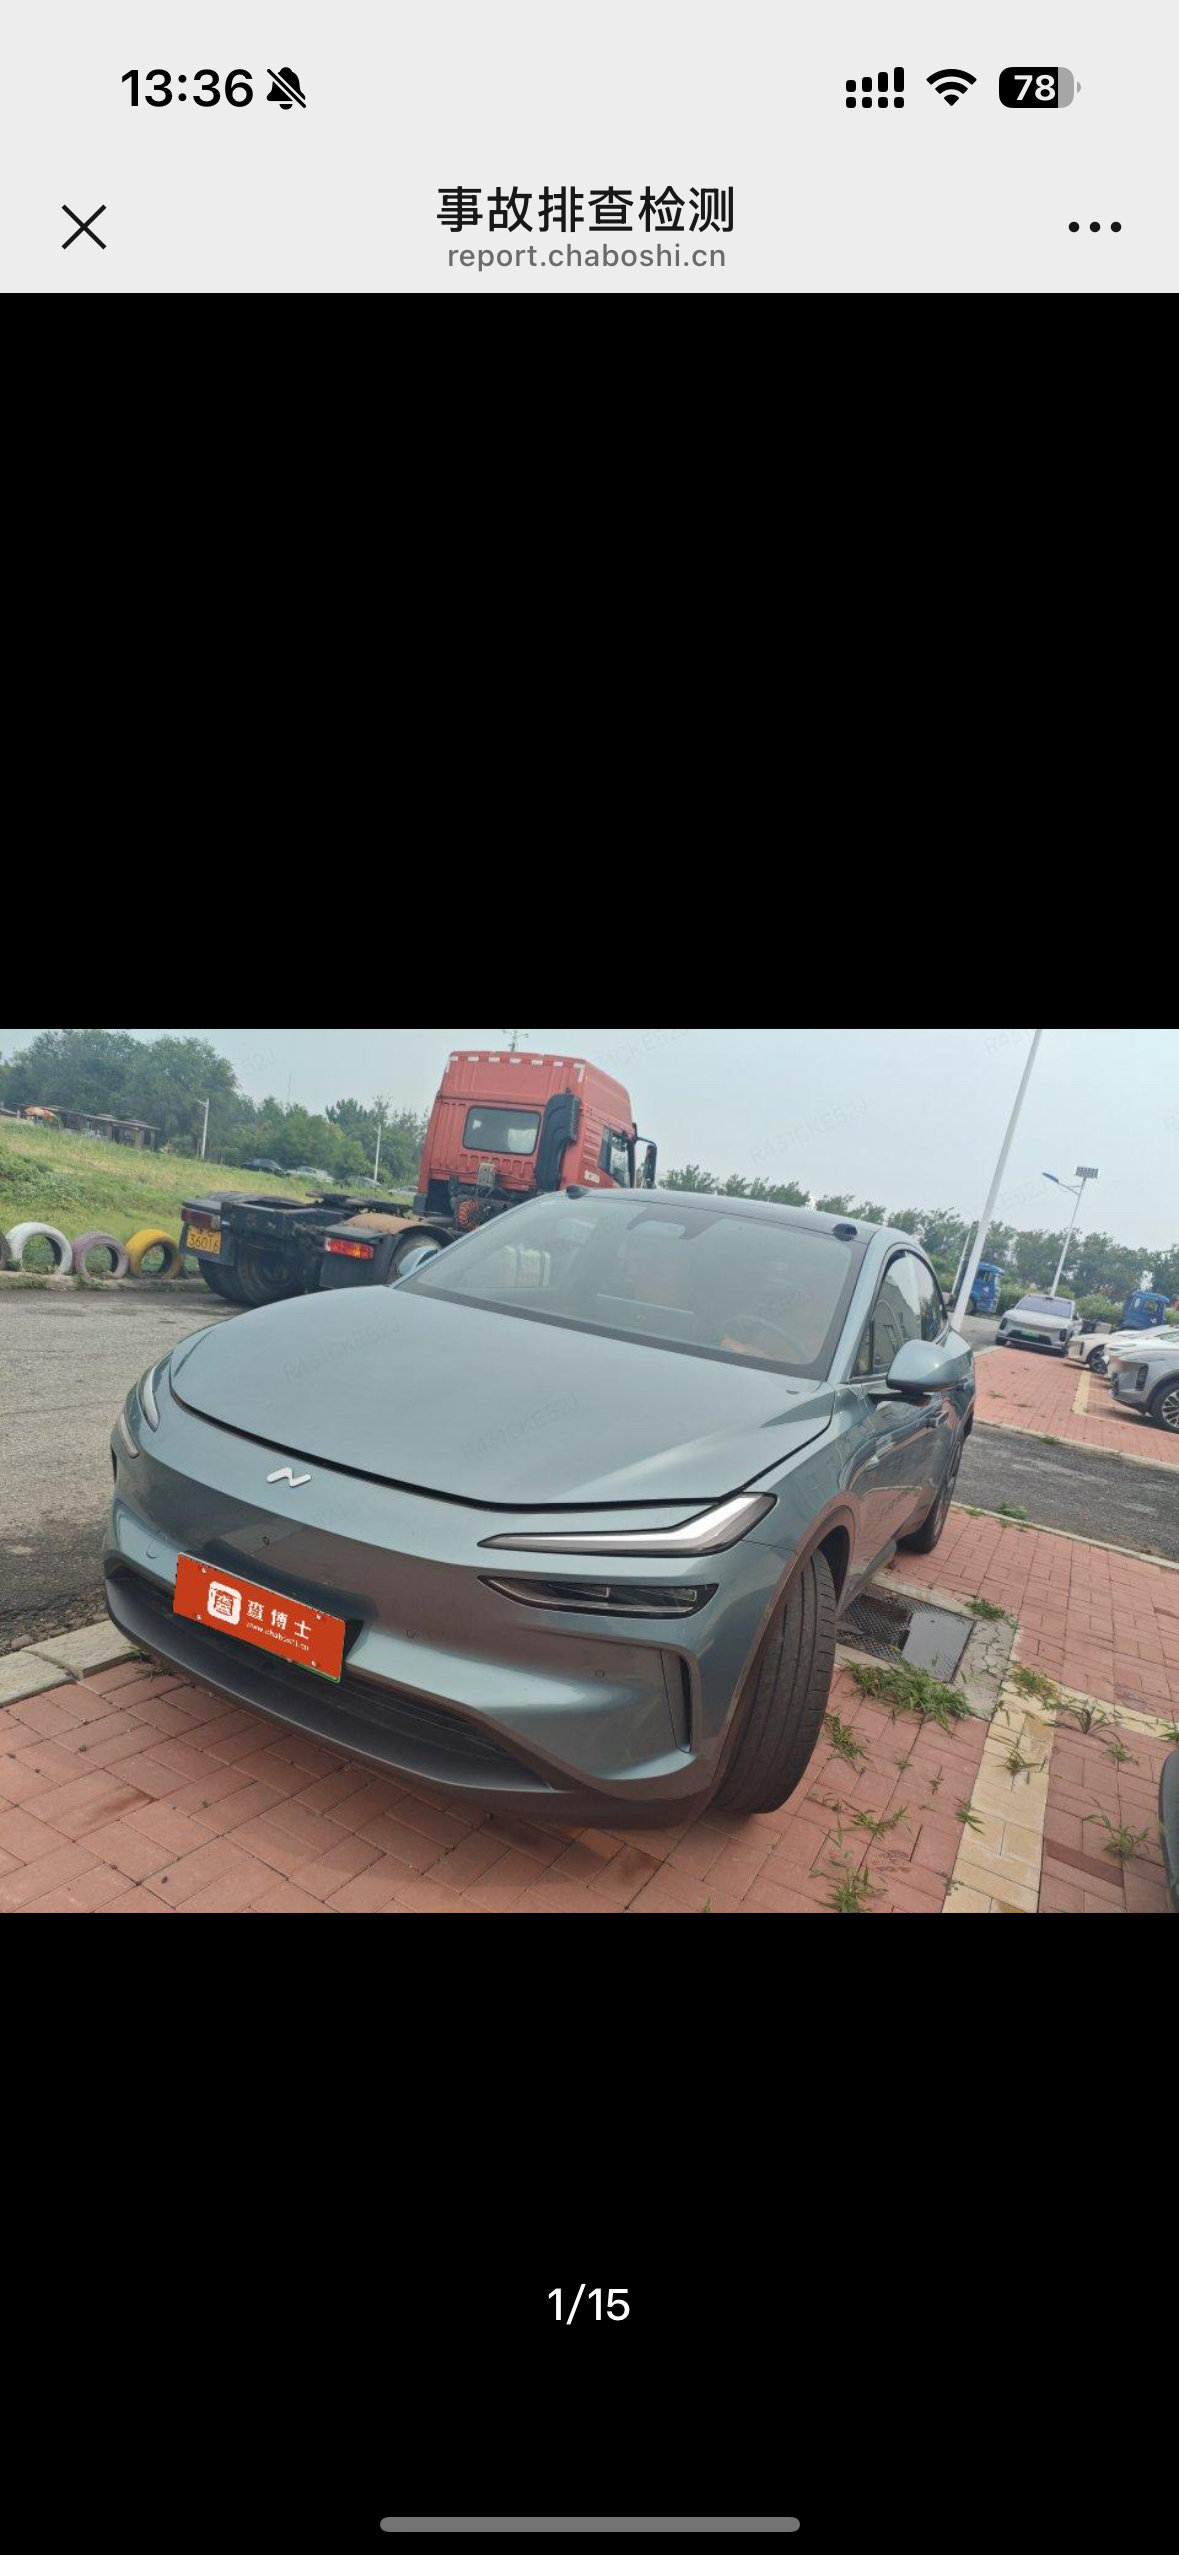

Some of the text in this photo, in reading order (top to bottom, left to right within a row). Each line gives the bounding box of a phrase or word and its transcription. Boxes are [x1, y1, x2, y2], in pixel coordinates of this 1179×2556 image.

[121, 68, 254, 108] 13:36
[1014, 74, 1056, 101] 78
[436, 186, 734, 233] 事故排查检测
[447, 243, 726, 273] report.chaboshi.cn
[548, 2283, 631, 2326] 1/15
